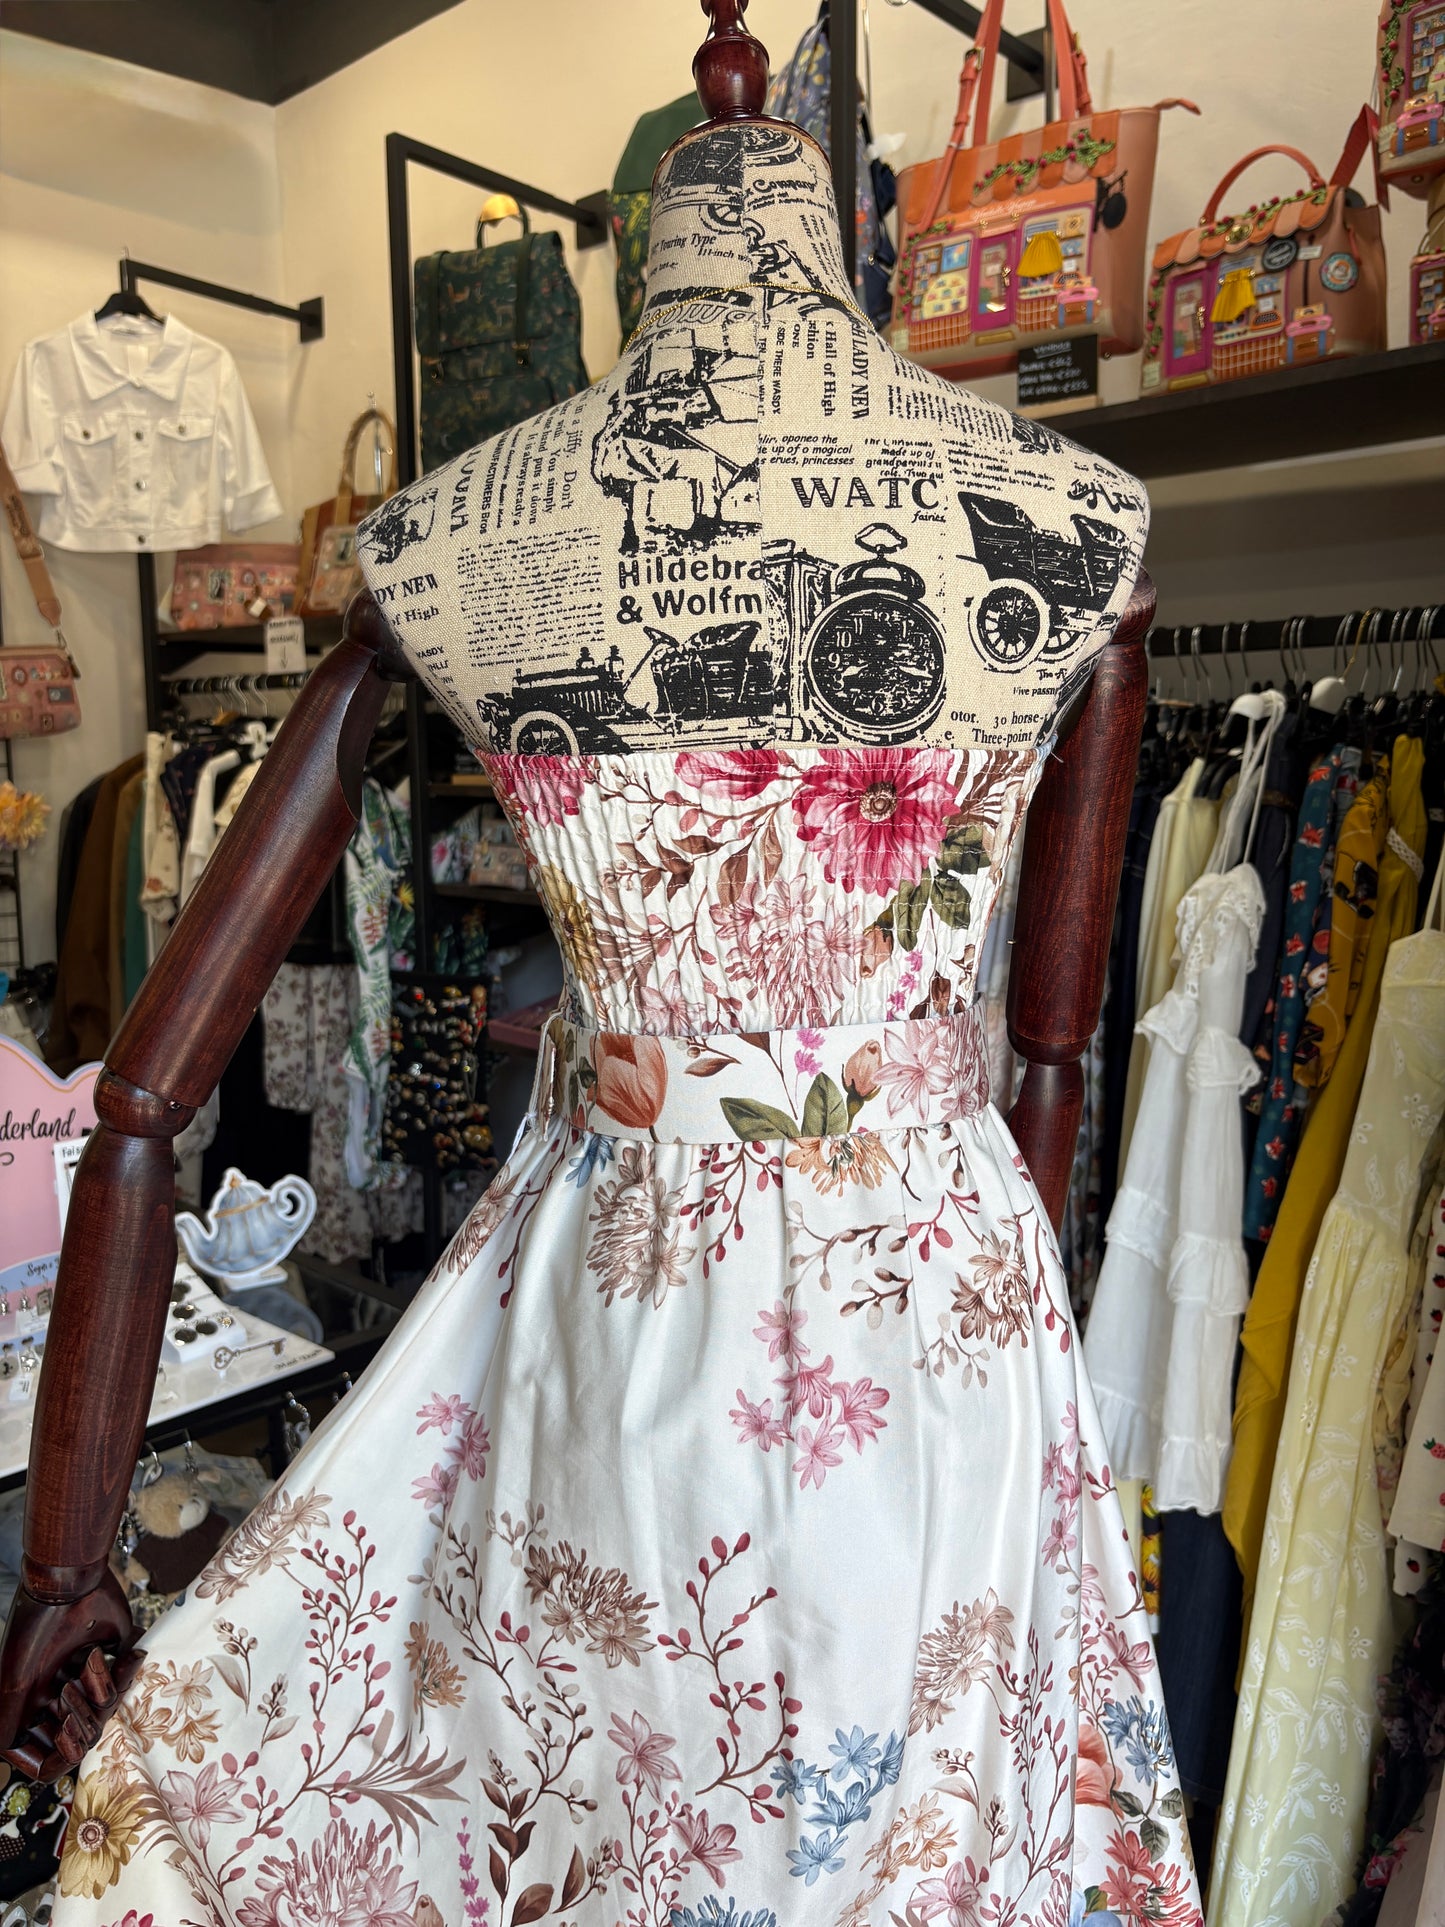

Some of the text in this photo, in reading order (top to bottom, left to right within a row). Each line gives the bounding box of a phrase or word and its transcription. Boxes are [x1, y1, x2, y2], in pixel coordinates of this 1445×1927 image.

[691, 233, 717, 247] Type
[792, 324, 801, 348] ONE
[773, 349, 784, 377] THERE
[851, 338, 869, 380] LADY
[821, 331, 838, 417] Hall of High
[822, 435, 838, 444] the
[548, 448, 562, 473] You
[771, 446, 786, 457] up
[787, 445, 801, 456] of
[533, 456, 544, 478] puts
[802, 457, 855, 468] princesses
[531, 482, 543, 492] it
[542, 478, 558, 514] simply
[561, 470, 578, 510] Don't
[791, 477, 939, 510] WATC
[529, 494, 542, 525] down
[480, 512, 491, 535] Bros
[404, 605, 440, 621] High
[616, 585, 762, 624] & Wolfm
[836, 630, 852, 648] 10
[828, 652, 841, 669] 9
[950, 710, 980, 724] otor.
[993, 716, 1007, 729] 30
[971, 728, 1033, 747] Three-point
